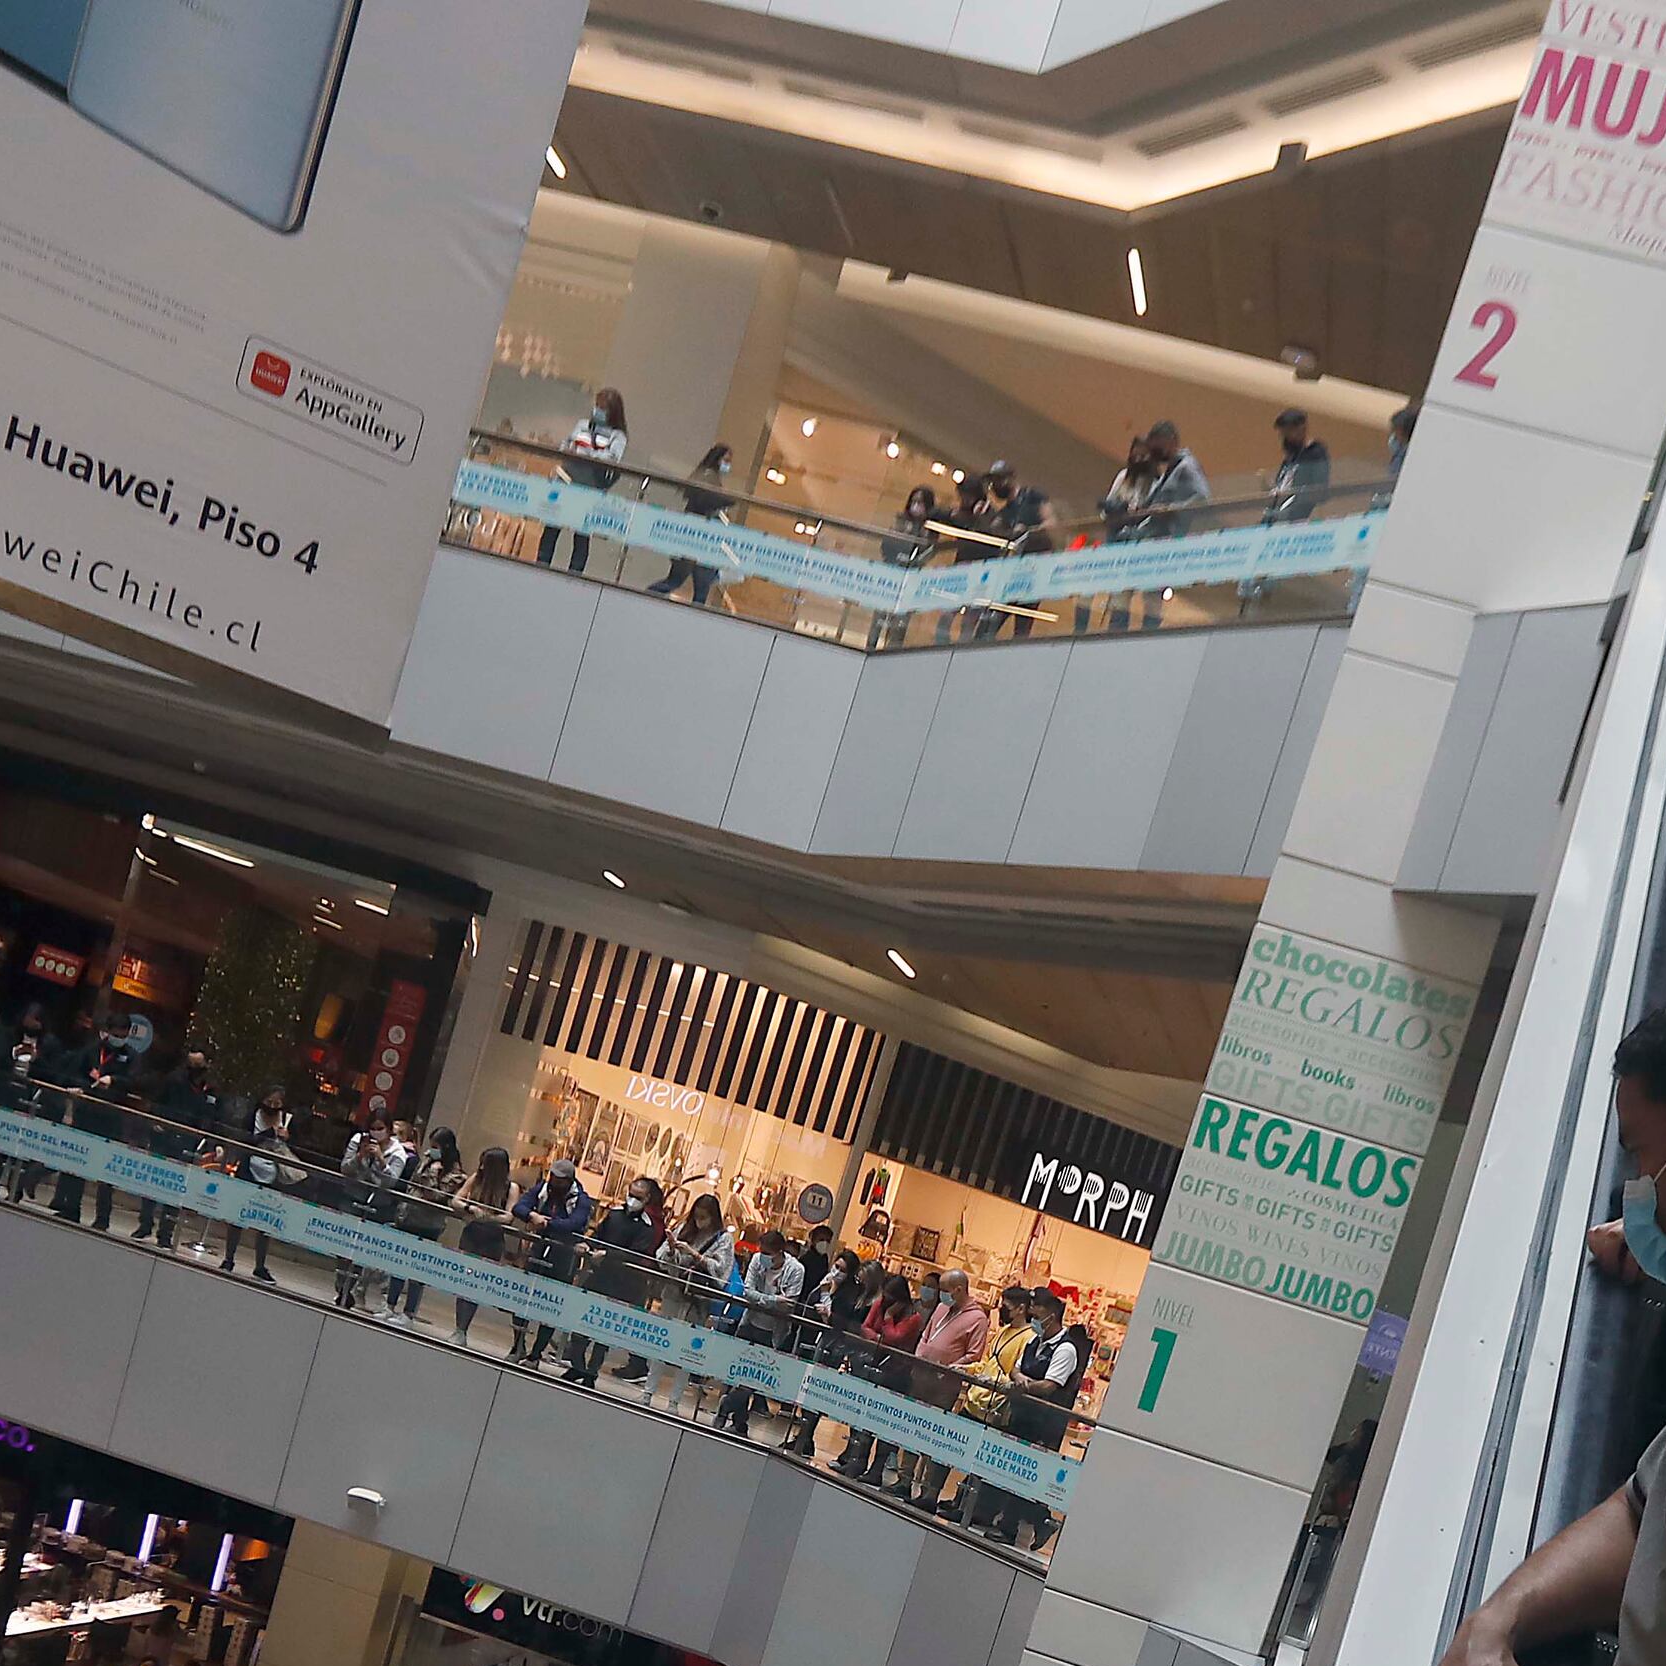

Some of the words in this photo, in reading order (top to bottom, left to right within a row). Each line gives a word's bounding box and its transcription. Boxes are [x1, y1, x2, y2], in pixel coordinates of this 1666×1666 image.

[1454, 300, 1518, 391] 2
[295, 387, 407, 453] AppGallery
[367, 397, 383, 414] EN
[3, 415, 180, 526] Huawei,
[197, 496, 282, 559] Piso
[293, 541, 322, 576] 4
[1251, 933, 1472, 1020] chocolates
[1239, 967, 1465, 1061] REGALOS
[1220, 1034, 1272, 1067] libros
[1300, 1058, 1356, 1090] books
[1383, 1083, 1436, 1114] libros
[0, 1121, 38, 1139] PUNTOS
[40, 1133, 58, 1146] DEL
[1191, 1098, 1419, 1208] REGALOS
[104, 1161, 117, 1172] AL
[135, 1170, 148, 1182] DE
[149, 1174, 187, 1194] MARZO
[112, 1153, 122, 1163] 22
[125, 1157, 139, 1168] DE
[140, 1162, 185, 1182] FEBRERO
[239, 1206, 287, 1233] CARNAVAL
[1020, 1152, 1154, 1244] MORPH
[1180, 1173, 1240, 1207] GIFTS
[1255, 1196, 1317, 1231] GIFTS
[1333, 1219, 1395, 1254] GIFTS
[308, 1217, 393, 1250] ¡ENCUENTRANOS
[395, 1244, 409, 1257] EN
[410, 1249, 464, 1275] DISTINTOS
[466, 1267, 509, 1288] PUNTOS
[510, 1280, 530, 1296] DEL
[531, 1289, 564, 1306] MALL!
[1174, 1203, 1239, 1237] VINOS
[1247, 1223, 1309, 1260] WINES
[1319, 1247, 1383, 1281] VINOS
[485, 1285, 510, 1300] Photo
[512, 1295, 562, 1316] opportunity
[1159, 1230, 1266, 1288] JUMBO
[1265, 1262, 1375, 1321] JUMBO
[581, 1315, 596, 1325] AL
[614, 1323, 629, 1334] DE
[630, 1327, 670, 1349] MARZO
[588, 1305, 601, 1316] 22
[604, 1310, 618, 1321] DE
[621, 1314, 669, 1337] FEBRERO
[1153, 1296, 1195, 1329] NIVEL
[729, 1364, 778, 1389] CARNAVAL
[1136, 1326, 1178, 1415] 1
[803, 1376, 857, 1400] ¡ENCUENTRANOS
[857, 1395, 867, 1405] EN
[867, 1399, 903, 1418] DISTINTOS
[903, 1412, 932, 1430] PUNTOS
[932, 1422, 945, 1435] DEL
[946, 1429, 970, 1445] MALL!
[931, 1436, 966, 1456] opportunity
[974, 1450, 984, 1460] AL
[986, 1454, 994, 1465] 28
[997, 1458, 1008, 1470] DE
[1009, 1465, 1038, 1482] MARZO
[981, 1441, 989, 1451] 22
[992, 1444, 1001, 1456] DE
[1003, 1449, 1038, 1469] FEBRERO
[522, 1596, 624, 1646] vtr.com
